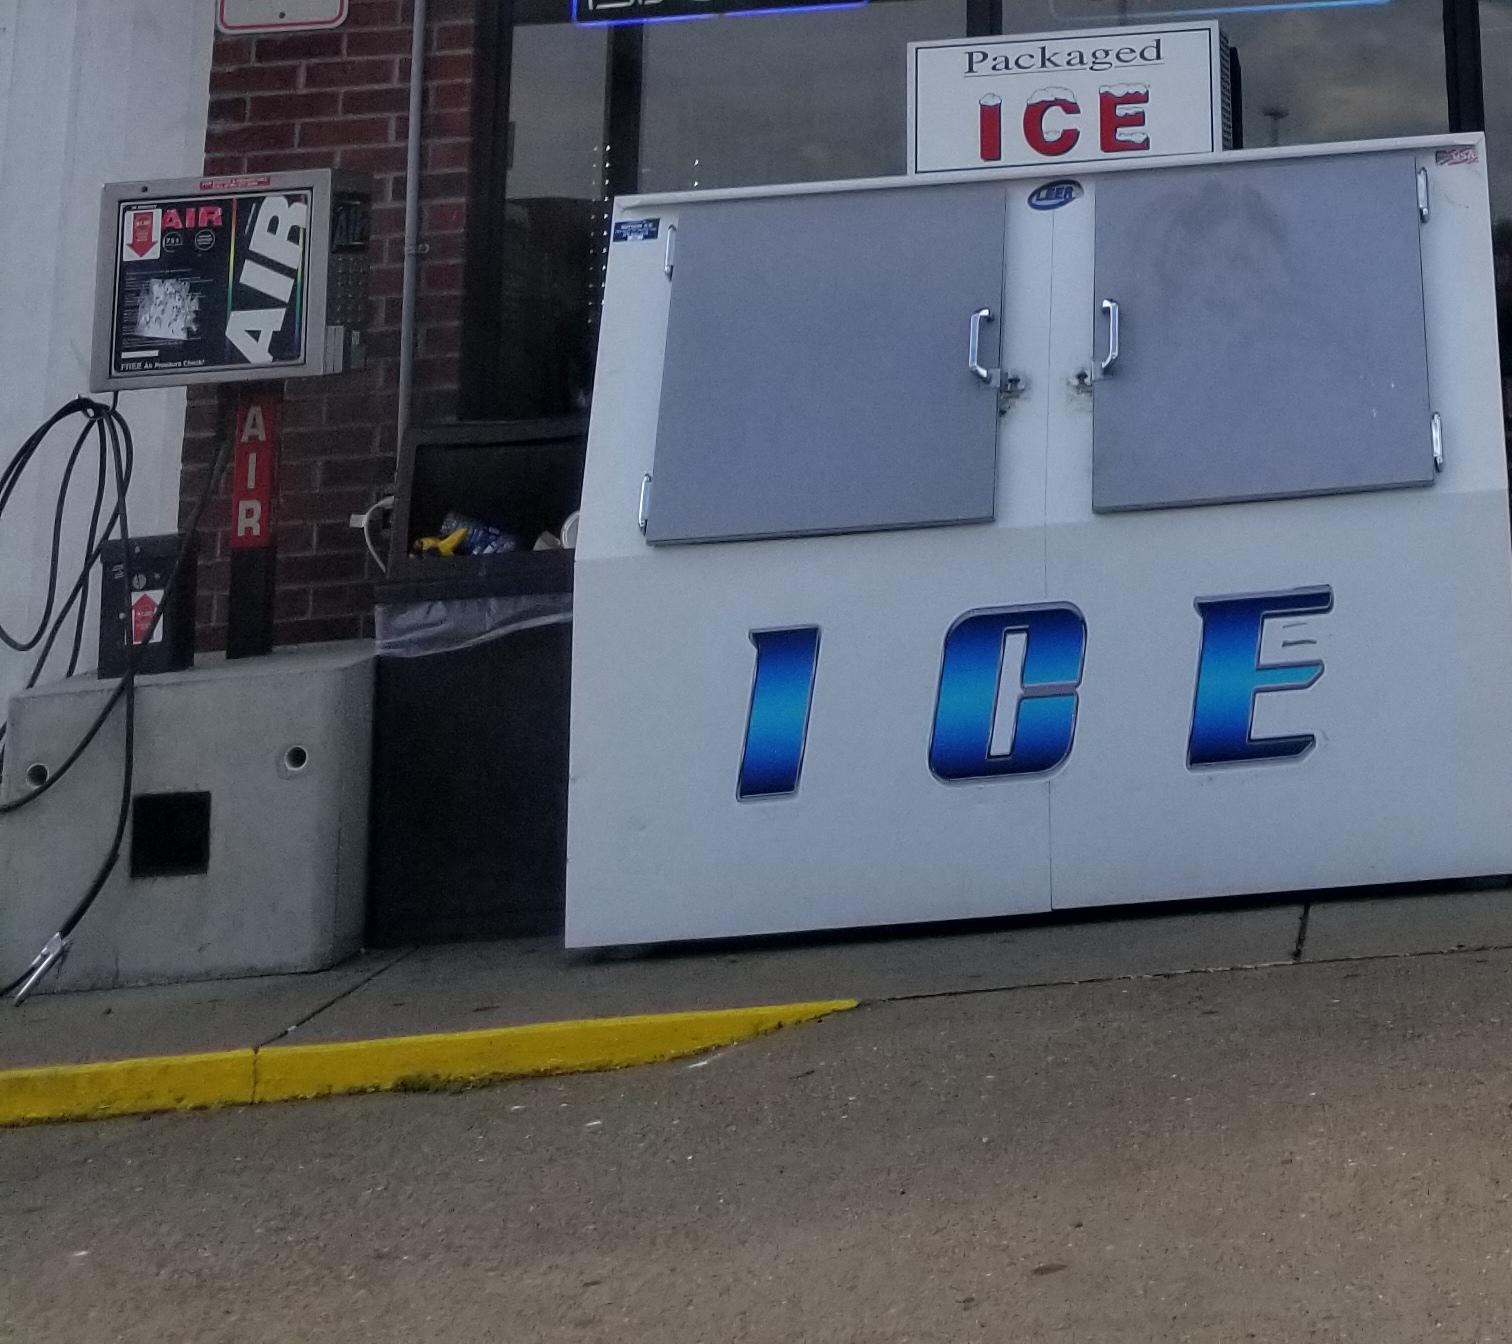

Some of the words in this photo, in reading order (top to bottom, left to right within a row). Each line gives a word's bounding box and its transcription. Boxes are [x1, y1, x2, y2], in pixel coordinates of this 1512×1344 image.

[964, 39, 1164, 74] Packaged
[979, 83, 1150, 162] ICE
[161, 206, 223, 229] AIR
[225, 195, 308, 366] AIR
[236, 404, 267, 537] AIR
[736, 583, 1334, 802] ICE
